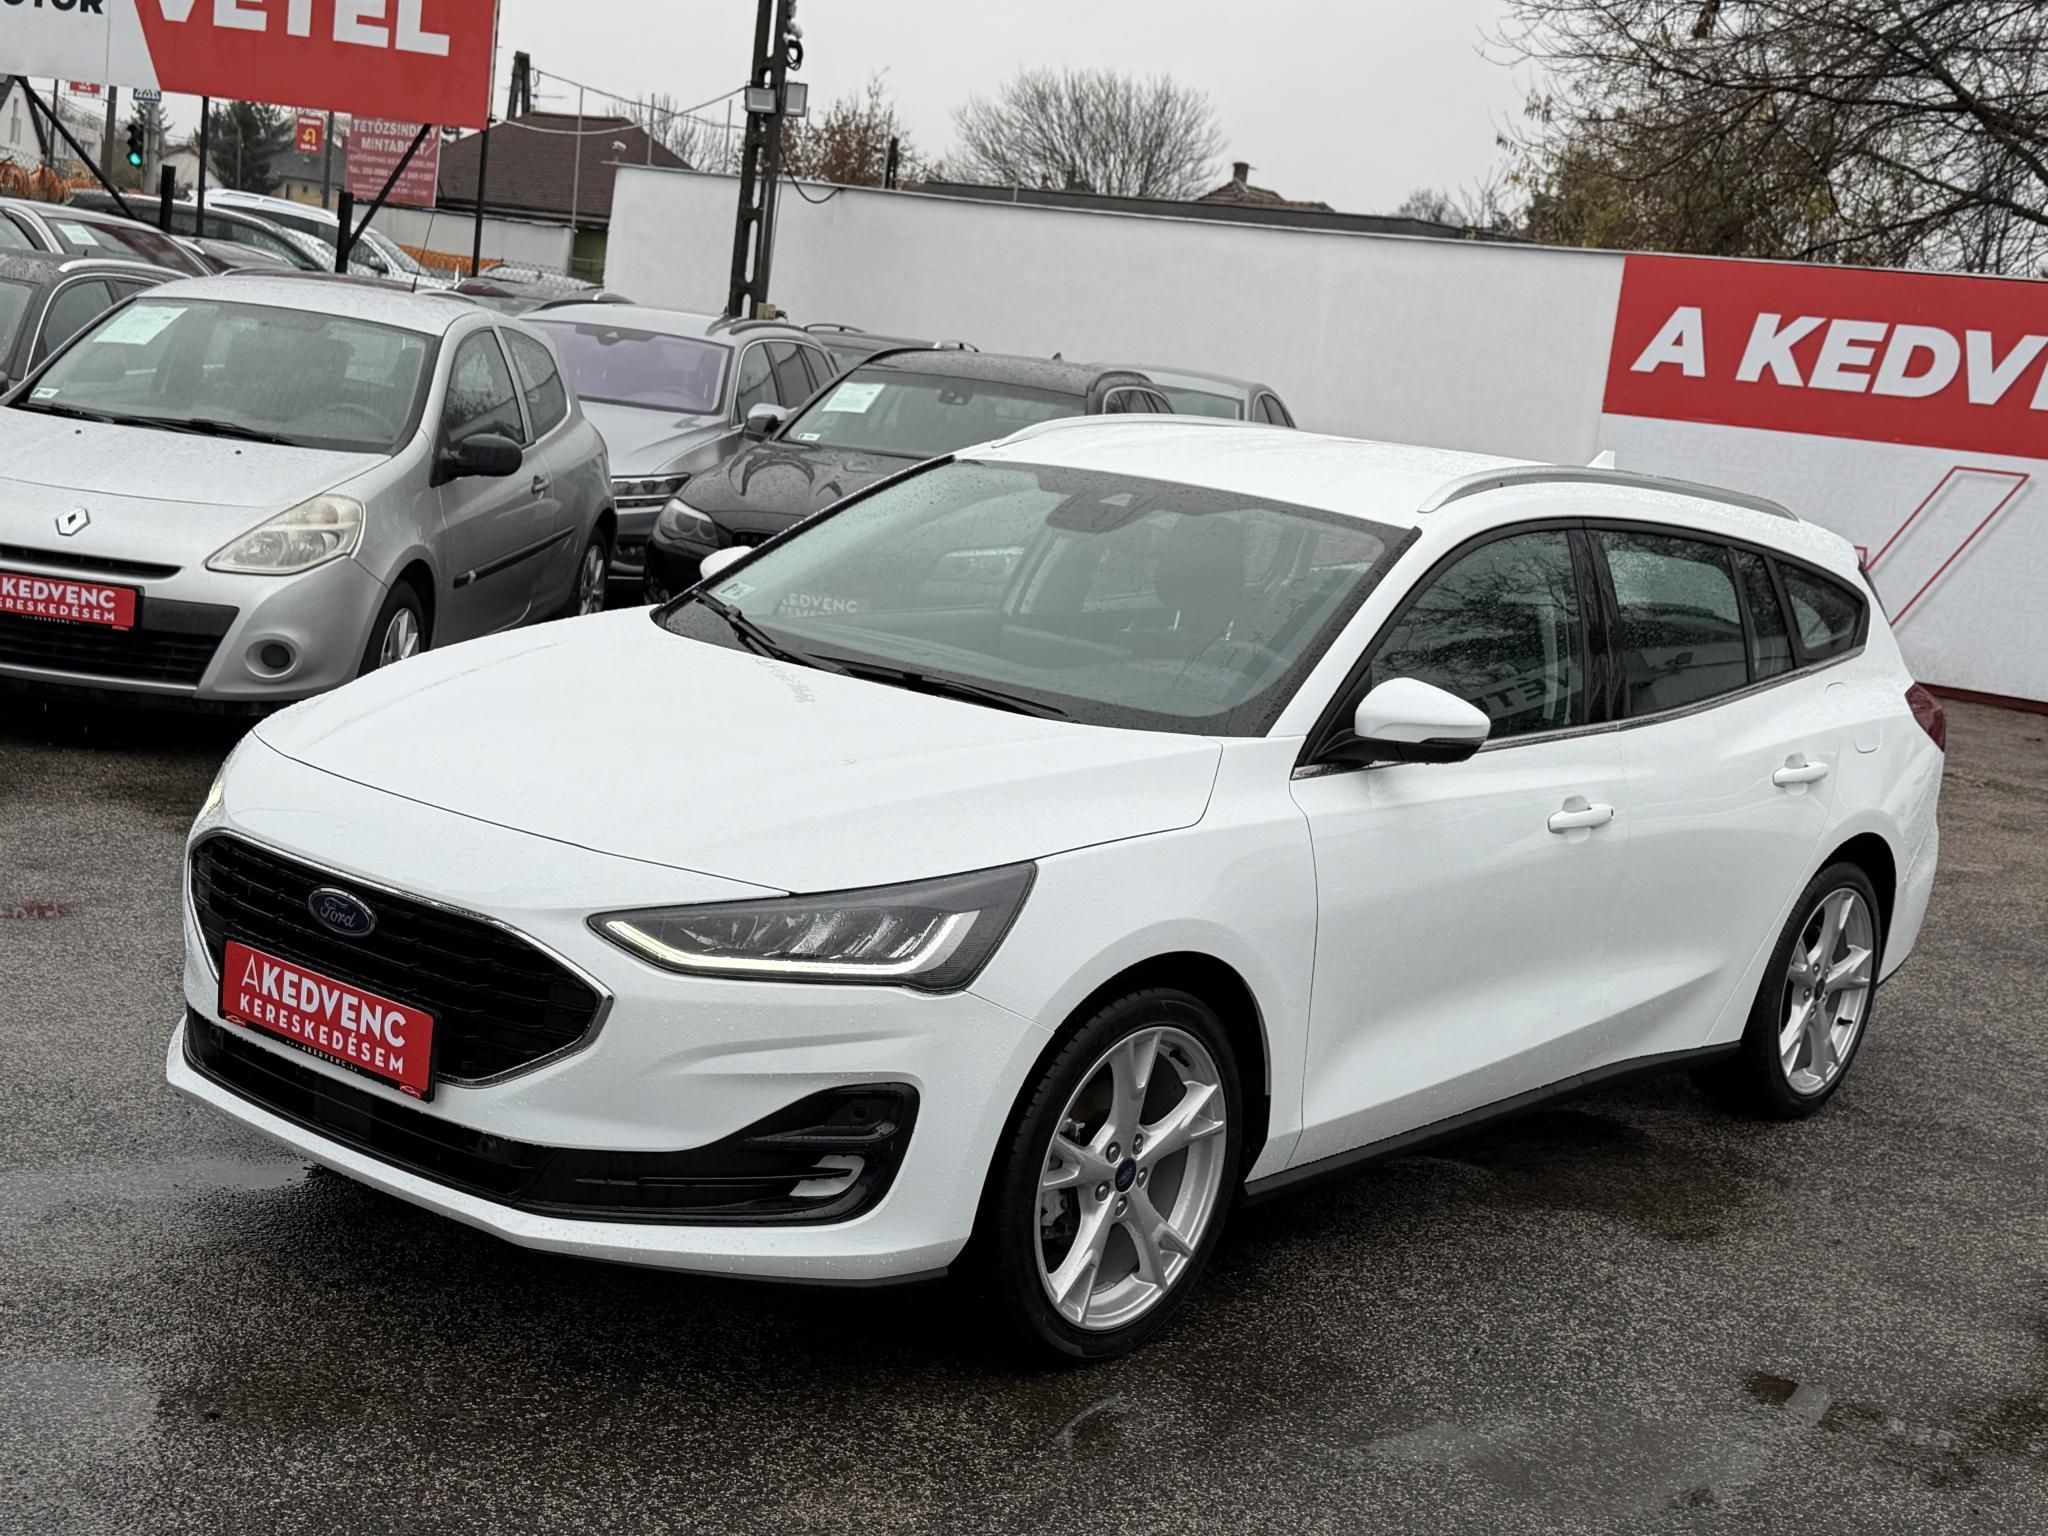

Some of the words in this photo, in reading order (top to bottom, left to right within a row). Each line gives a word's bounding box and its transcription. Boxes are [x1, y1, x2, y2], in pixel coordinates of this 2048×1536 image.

[1629, 305, 1706, 378] A
[1735, 312, 2048, 411] KEDV
[320, 896, 356, 929] Ford
[239, 992, 404, 1076] KERESKEDÉSEM
